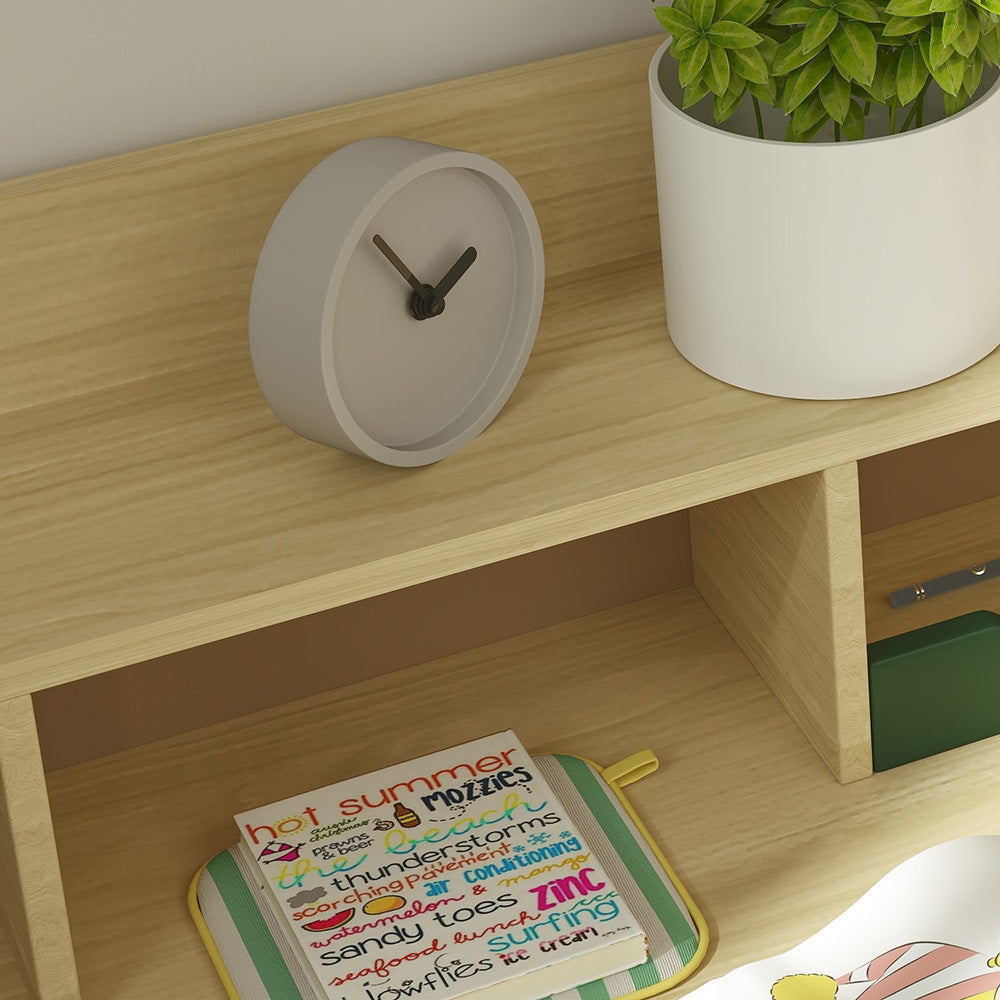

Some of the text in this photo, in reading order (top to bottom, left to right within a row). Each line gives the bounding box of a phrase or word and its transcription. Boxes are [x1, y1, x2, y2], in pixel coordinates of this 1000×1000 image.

[245, 748, 517, 845] hot summer
[272, 793, 548, 889] the beach
[312, 833, 370, 857] prawns
[323, 839, 375, 860] & beer
[331, 812, 562, 892] thunderstorms
[423, 836, 583, 897] air conditioning
[292, 843, 512, 921] scorching pavement
[310, 853, 591, 949] watermelon & mango
[320, 893, 518, 966] sandy toes
[328, 911, 541, 986] seafood lunch
[487, 900, 620, 953] surfing
[499, 949, 530, 967] ice
[539, 927, 598, 953] cream
[342, 958, 494, 1000] lowflies
